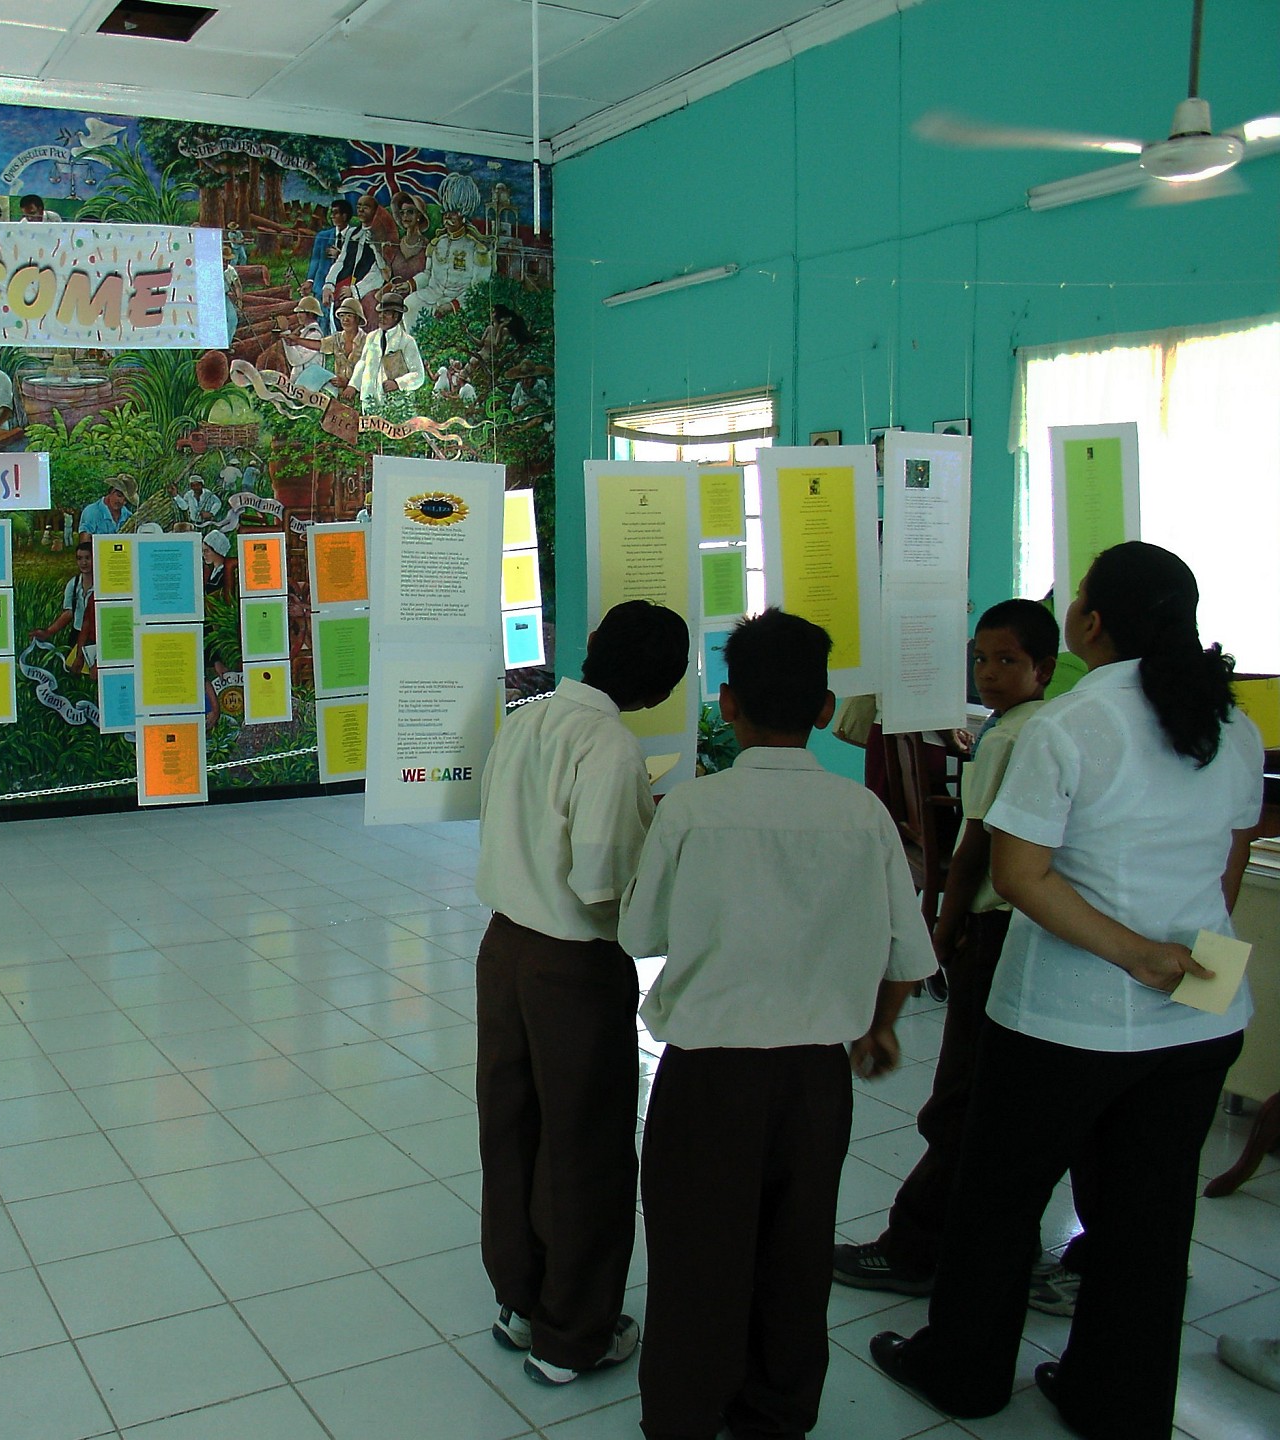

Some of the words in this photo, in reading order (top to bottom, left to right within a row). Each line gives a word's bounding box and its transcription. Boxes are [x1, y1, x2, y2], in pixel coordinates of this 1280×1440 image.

[49, 147, 67, 159] Pax
[276, 374, 304, 399] DAYS
[309, 392, 327, 407] OF
[361, 418, 411, 437] EMPIRE
[263, 501, 281, 514] and
[402, 768, 426, 782] WE
[431, 767, 472, 782] CARE
